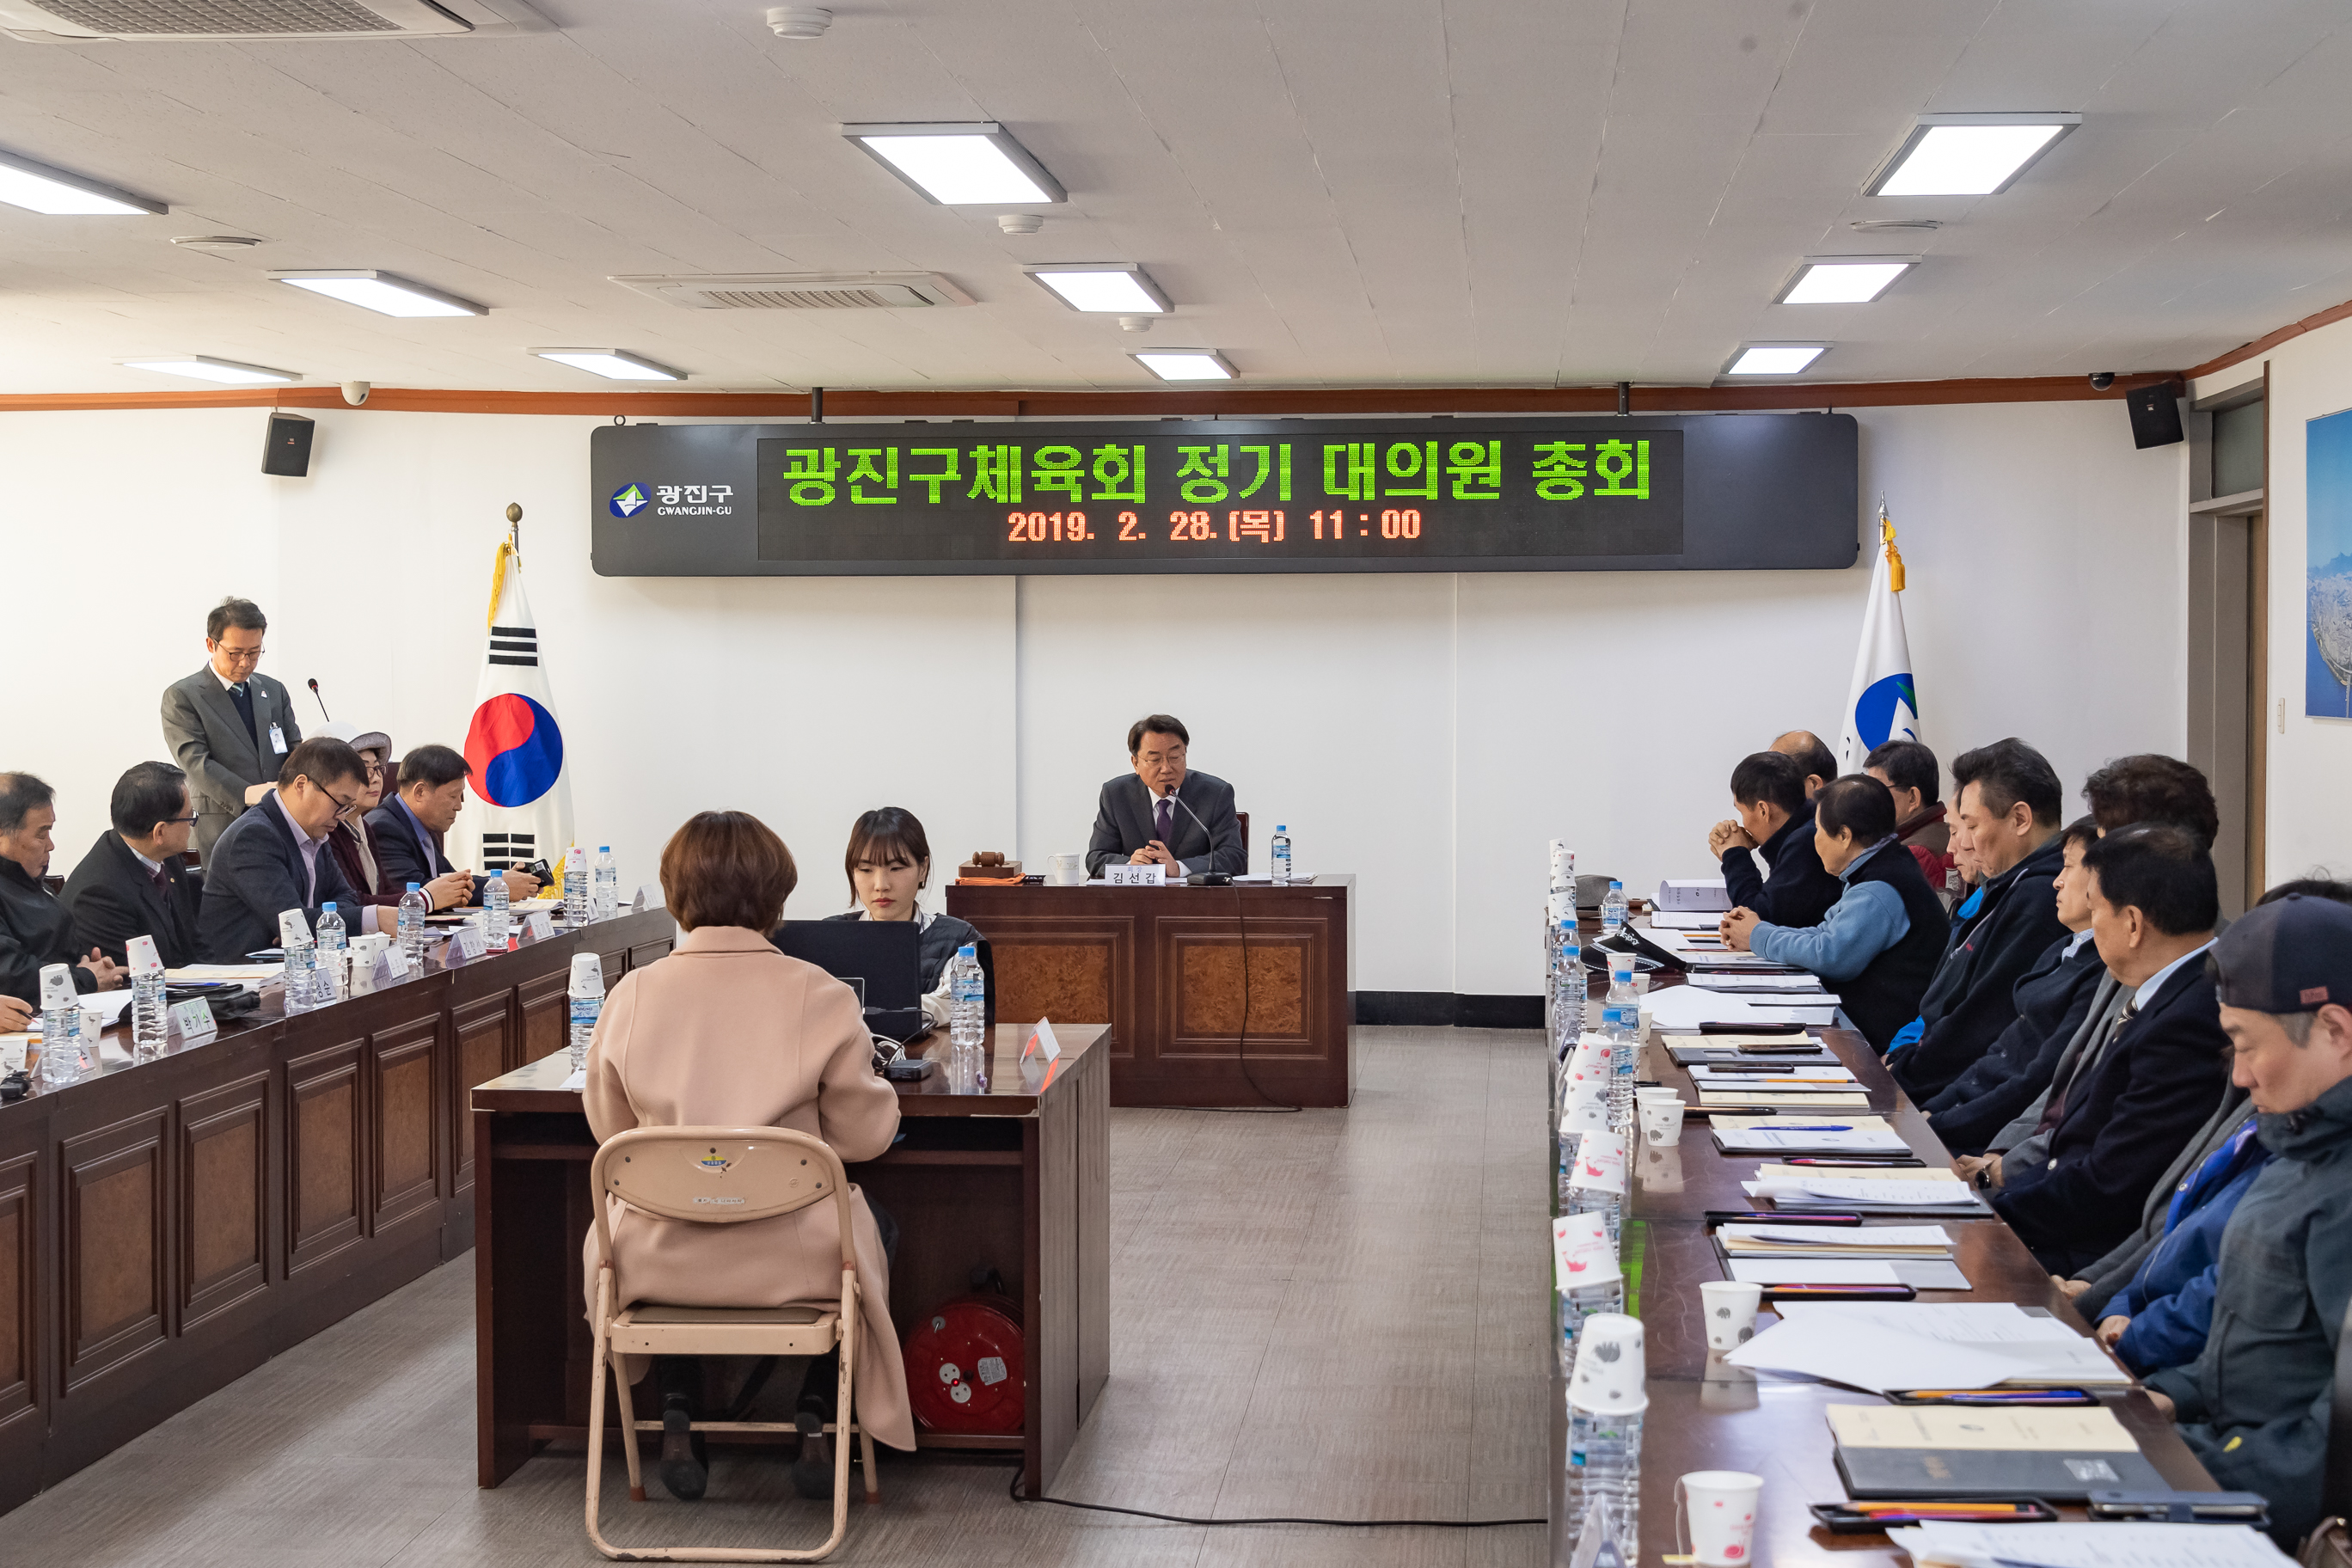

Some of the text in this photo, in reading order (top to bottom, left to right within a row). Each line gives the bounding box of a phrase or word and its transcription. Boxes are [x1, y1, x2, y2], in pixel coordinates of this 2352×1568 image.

[783, 439, 1651, 507] 광진구체육회 정기 대의원 총회
[656, 485, 734, 505] 광진구
[657, 505, 732, 517] GWANGJIN-GU
[1008, 511, 1096, 542] 2019.
[1118, 511, 1148, 542] 2.
[1113, 873, 1156, 885] 김선갑
[183, 1012, 211, 1034] 박기수
